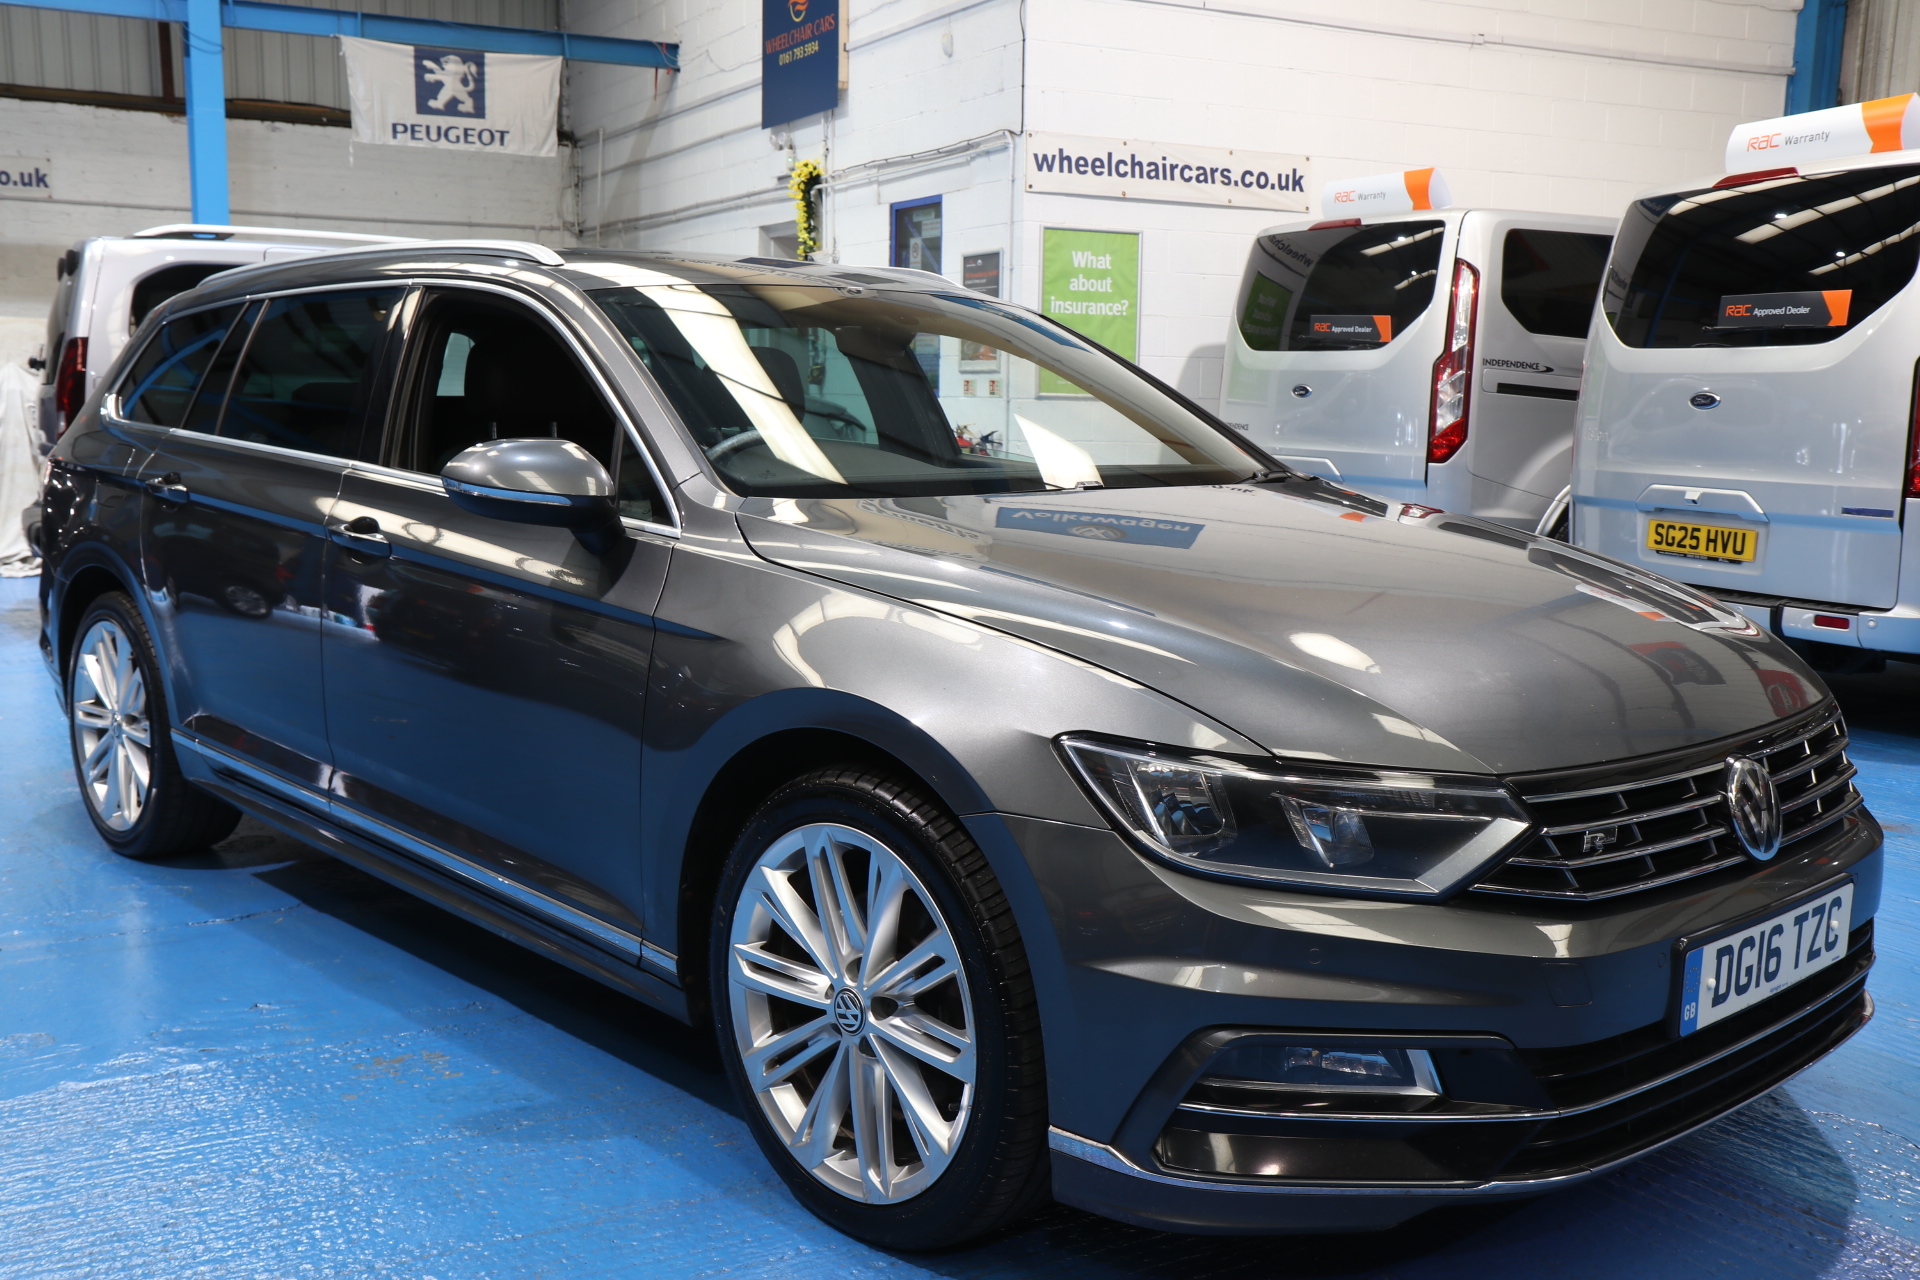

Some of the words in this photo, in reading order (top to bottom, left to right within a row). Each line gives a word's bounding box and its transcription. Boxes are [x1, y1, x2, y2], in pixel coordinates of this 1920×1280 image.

[766, 23, 812, 54] WHEELCHAIR
[813, 13, 835, 35] CARS
[779, 51, 793, 66] 0161
[793, 46, 804, 60] 793
[804, 40, 819, 57] 5934
[391, 122, 510, 147] PEUGEOT
[1785, 131, 1830, 146] Warranty
[1033, 148, 1305, 192] wheelchaircars.co.uk
[1358, 191, 1386, 201] Warranty
[1072, 251, 1112, 269] What
[1069, 274, 1113, 292] about
[1050, 296, 1129, 316] insurance?
[1753, 306, 1785, 317] Approved
[1786, 306, 1811, 315] Dealer
[1331, 325, 1354, 333] Approved
[1355, 325, 1372, 333] Dealer
[1482, 358, 1540, 370] INDEPENDENCE
[1653, 523, 1702, 550] SG25
[1705, 528, 1747, 555] HVU
[1711, 924, 1785, 1009] DG16
[1793, 896, 1843, 970] TZC
[1684, 1002, 1696, 1021] GB
